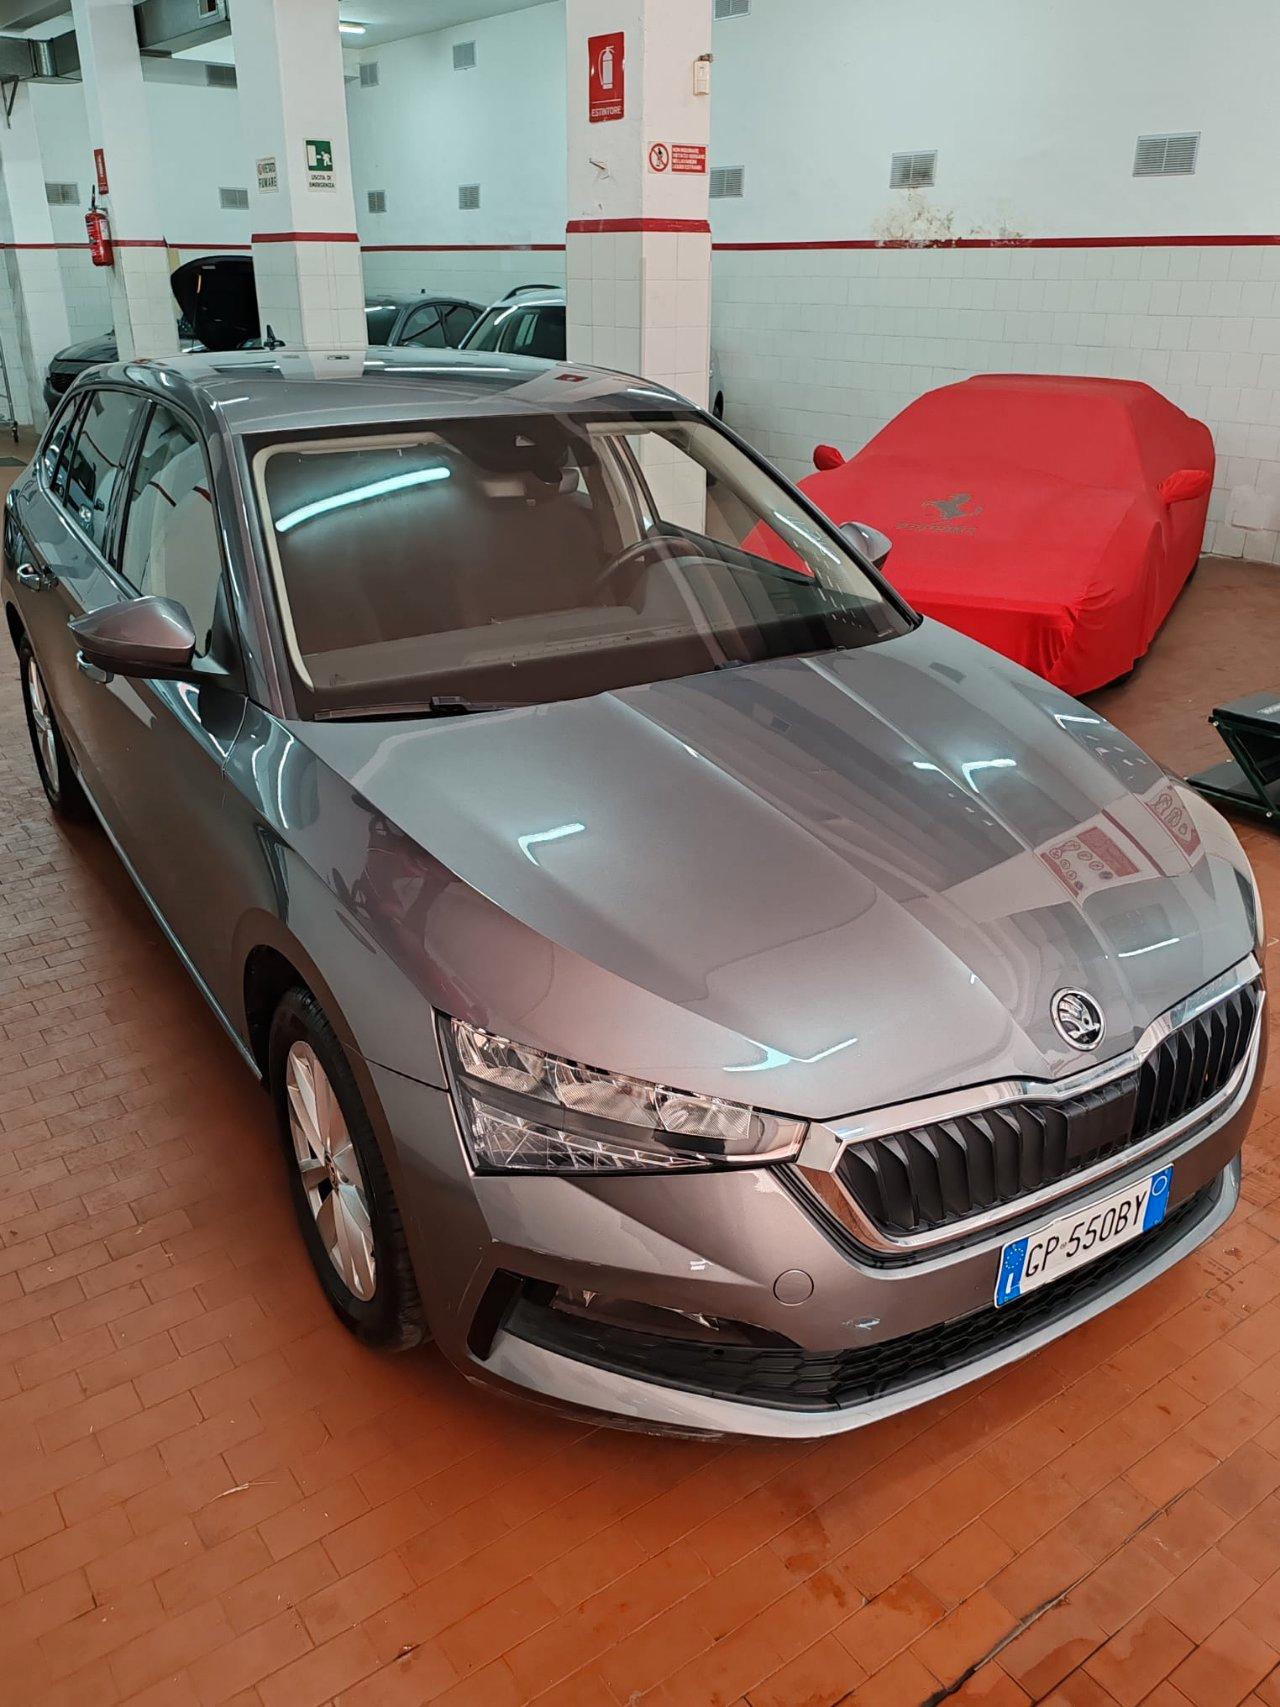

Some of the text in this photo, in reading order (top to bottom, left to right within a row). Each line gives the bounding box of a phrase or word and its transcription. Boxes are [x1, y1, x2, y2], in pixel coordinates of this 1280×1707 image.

[591, 106, 622, 117] ESTINTORE
[258, 176, 277, 189] FUMARE
[1025, 1190, 1148, 1278] GP 550BY
